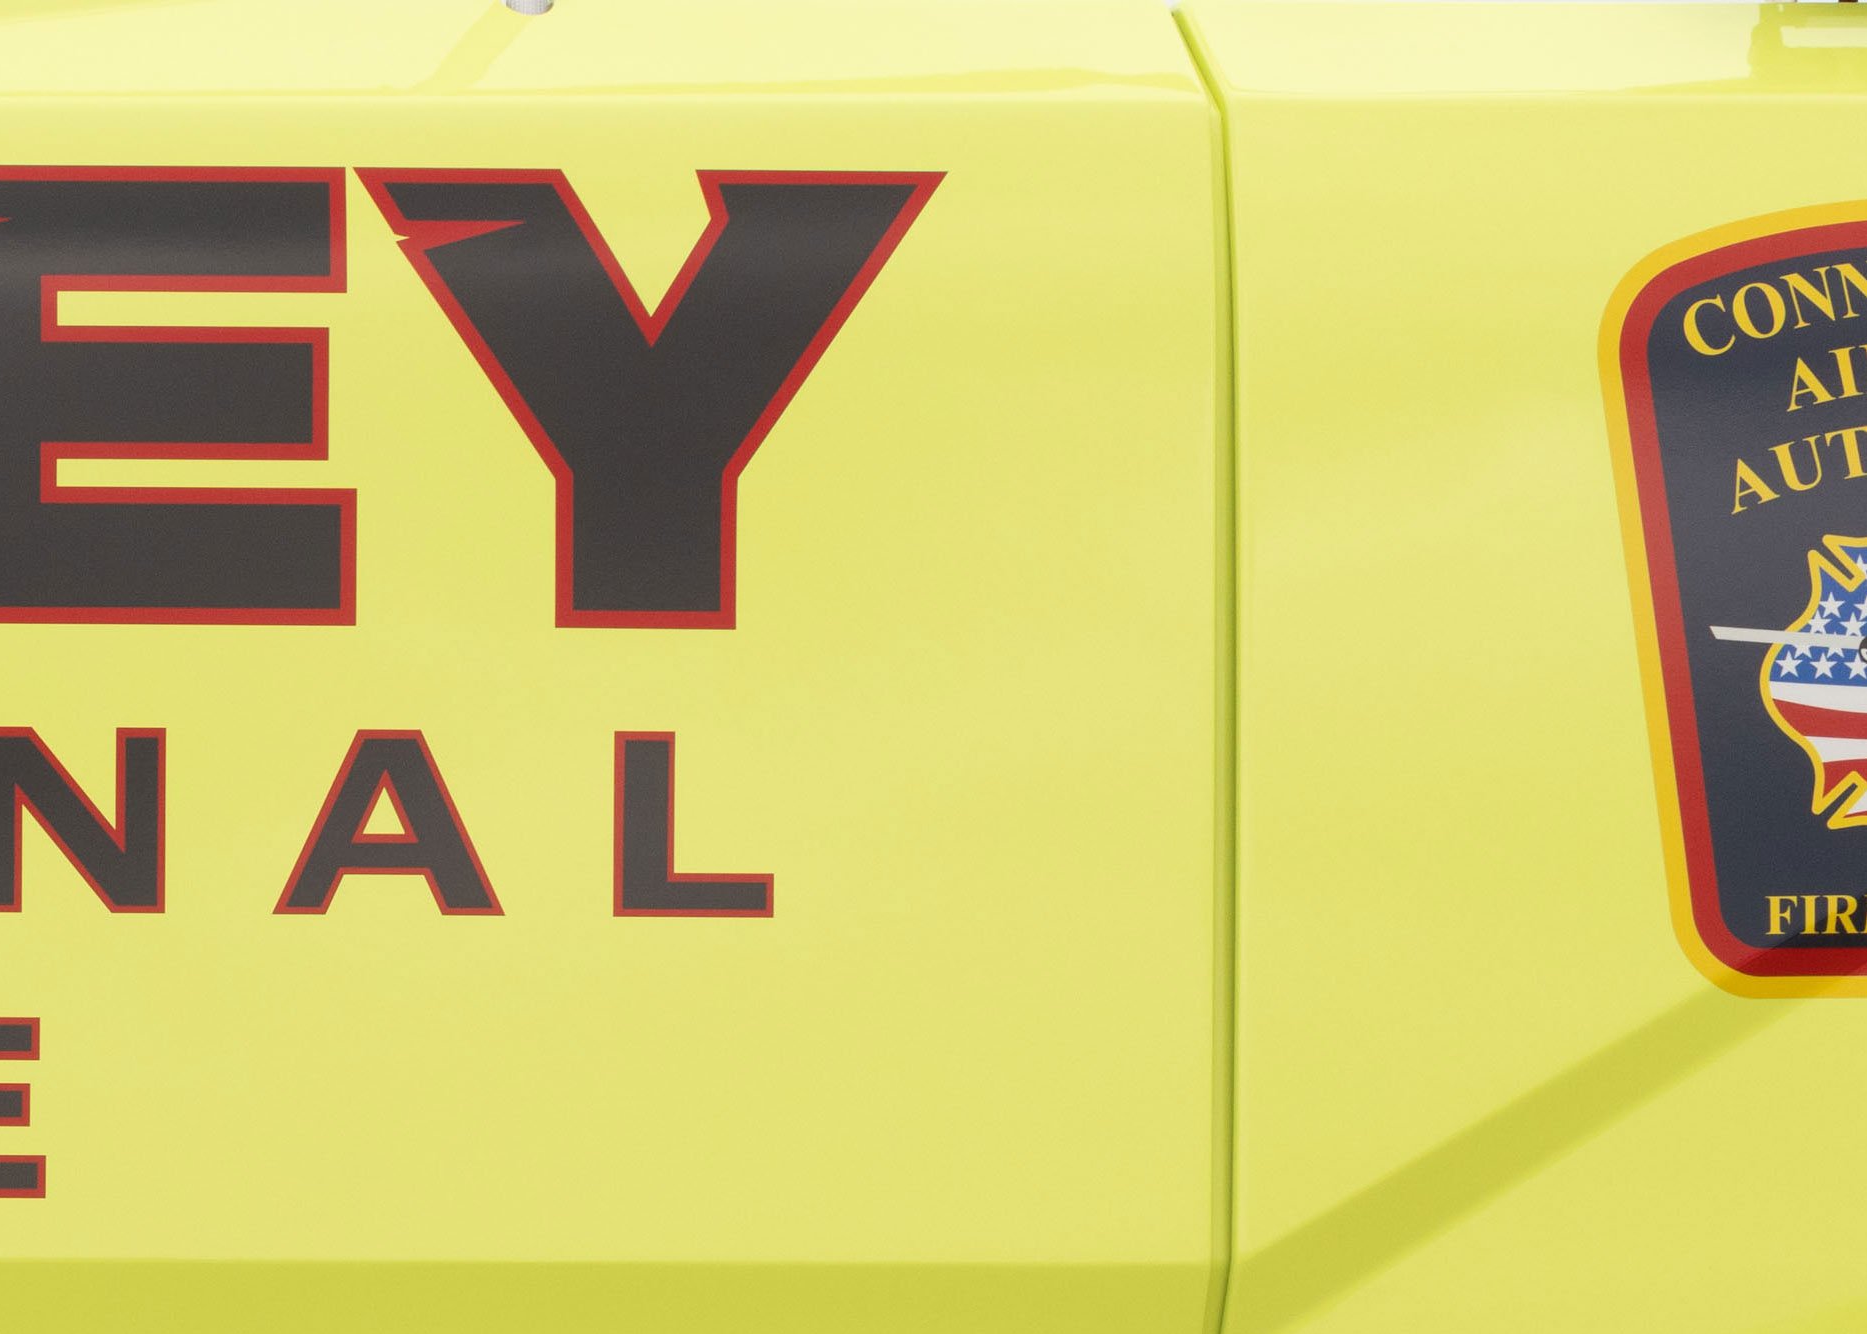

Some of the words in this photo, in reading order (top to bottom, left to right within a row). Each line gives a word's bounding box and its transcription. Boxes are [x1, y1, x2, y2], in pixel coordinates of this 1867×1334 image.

[1683, 263, 1867, 356] CONN
[1787, 344, 1867, 413] AI
[1731, 425, 1867, 515] AUT
[1765, 894, 1867, 935] FIR
